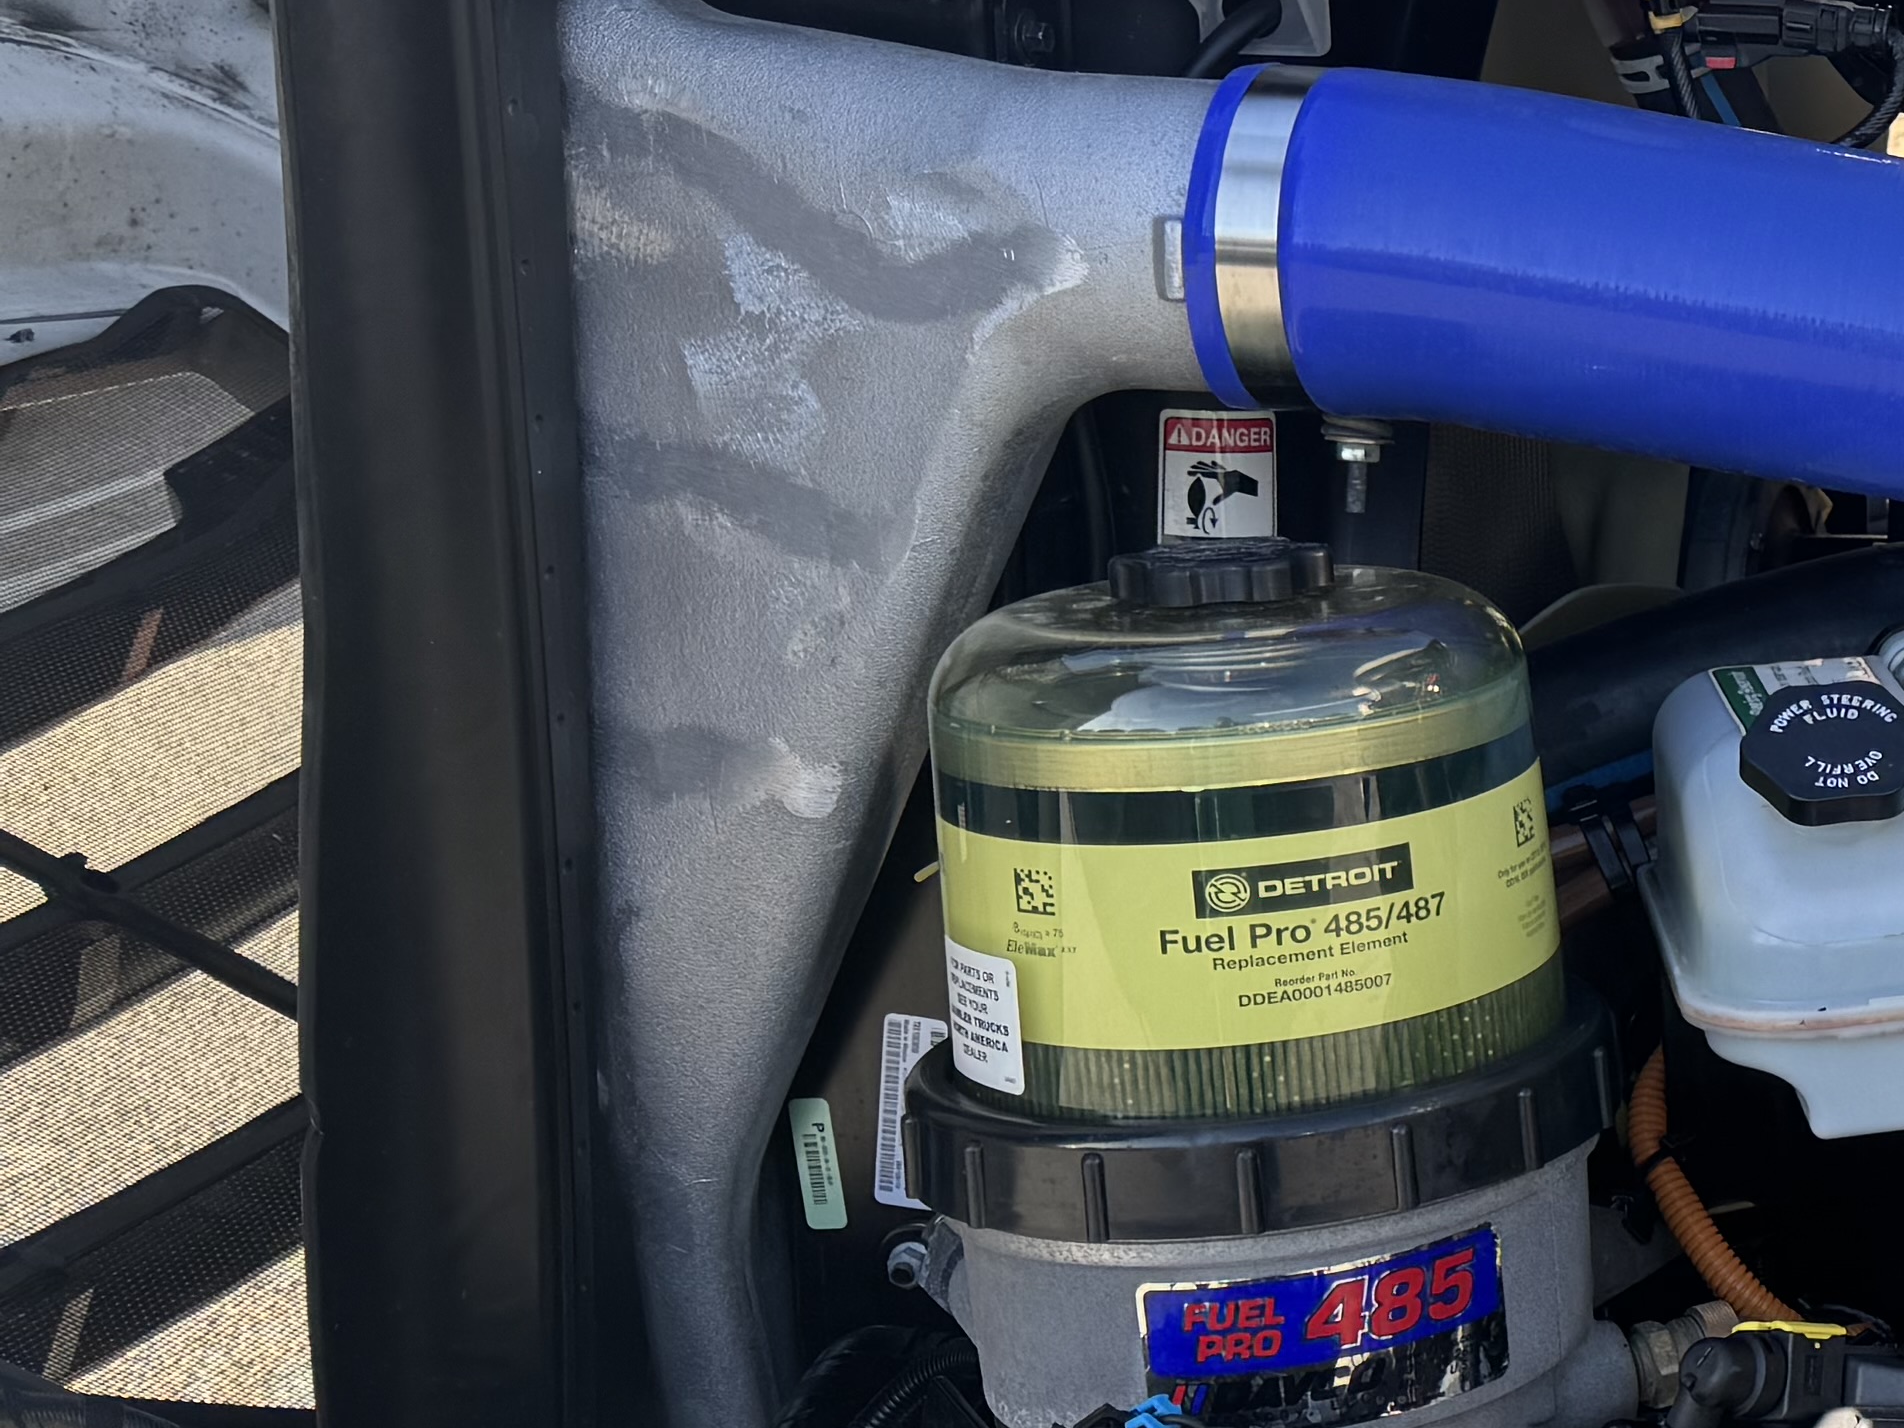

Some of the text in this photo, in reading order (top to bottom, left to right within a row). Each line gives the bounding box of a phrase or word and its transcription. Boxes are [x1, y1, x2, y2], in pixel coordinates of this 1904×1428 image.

[1192, 427, 1270, 447] DANGER
[1770, 694, 1898, 733] POWER STEERING
[1803, 708, 1859, 725] FLUID
[1804, 750, 1883, 775] OVERFILL
[1815, 770, 1879, 788] DO NOT
[1258, 861, 1399, 899] DETROIT
[1159, 892, 1445, 955] Fuel Pro 485/487
[1212, 931, 1408, 971] Replacement Element
[982, 970, 995, 984] OR
[1275, 974, 1315, 987] Reorder
[1318, 971, 1339, 982] Part
[1238, 973, 1392, 1007] DDEA0001485007
[974, 1016, 1010, 1037] TRUCKS
[970, 1028, 1009, 1053] AMERICA
[1183, 1247, 1474, 1349] FUEL 485
[1196, 1329, 1283, 1364] PRO
